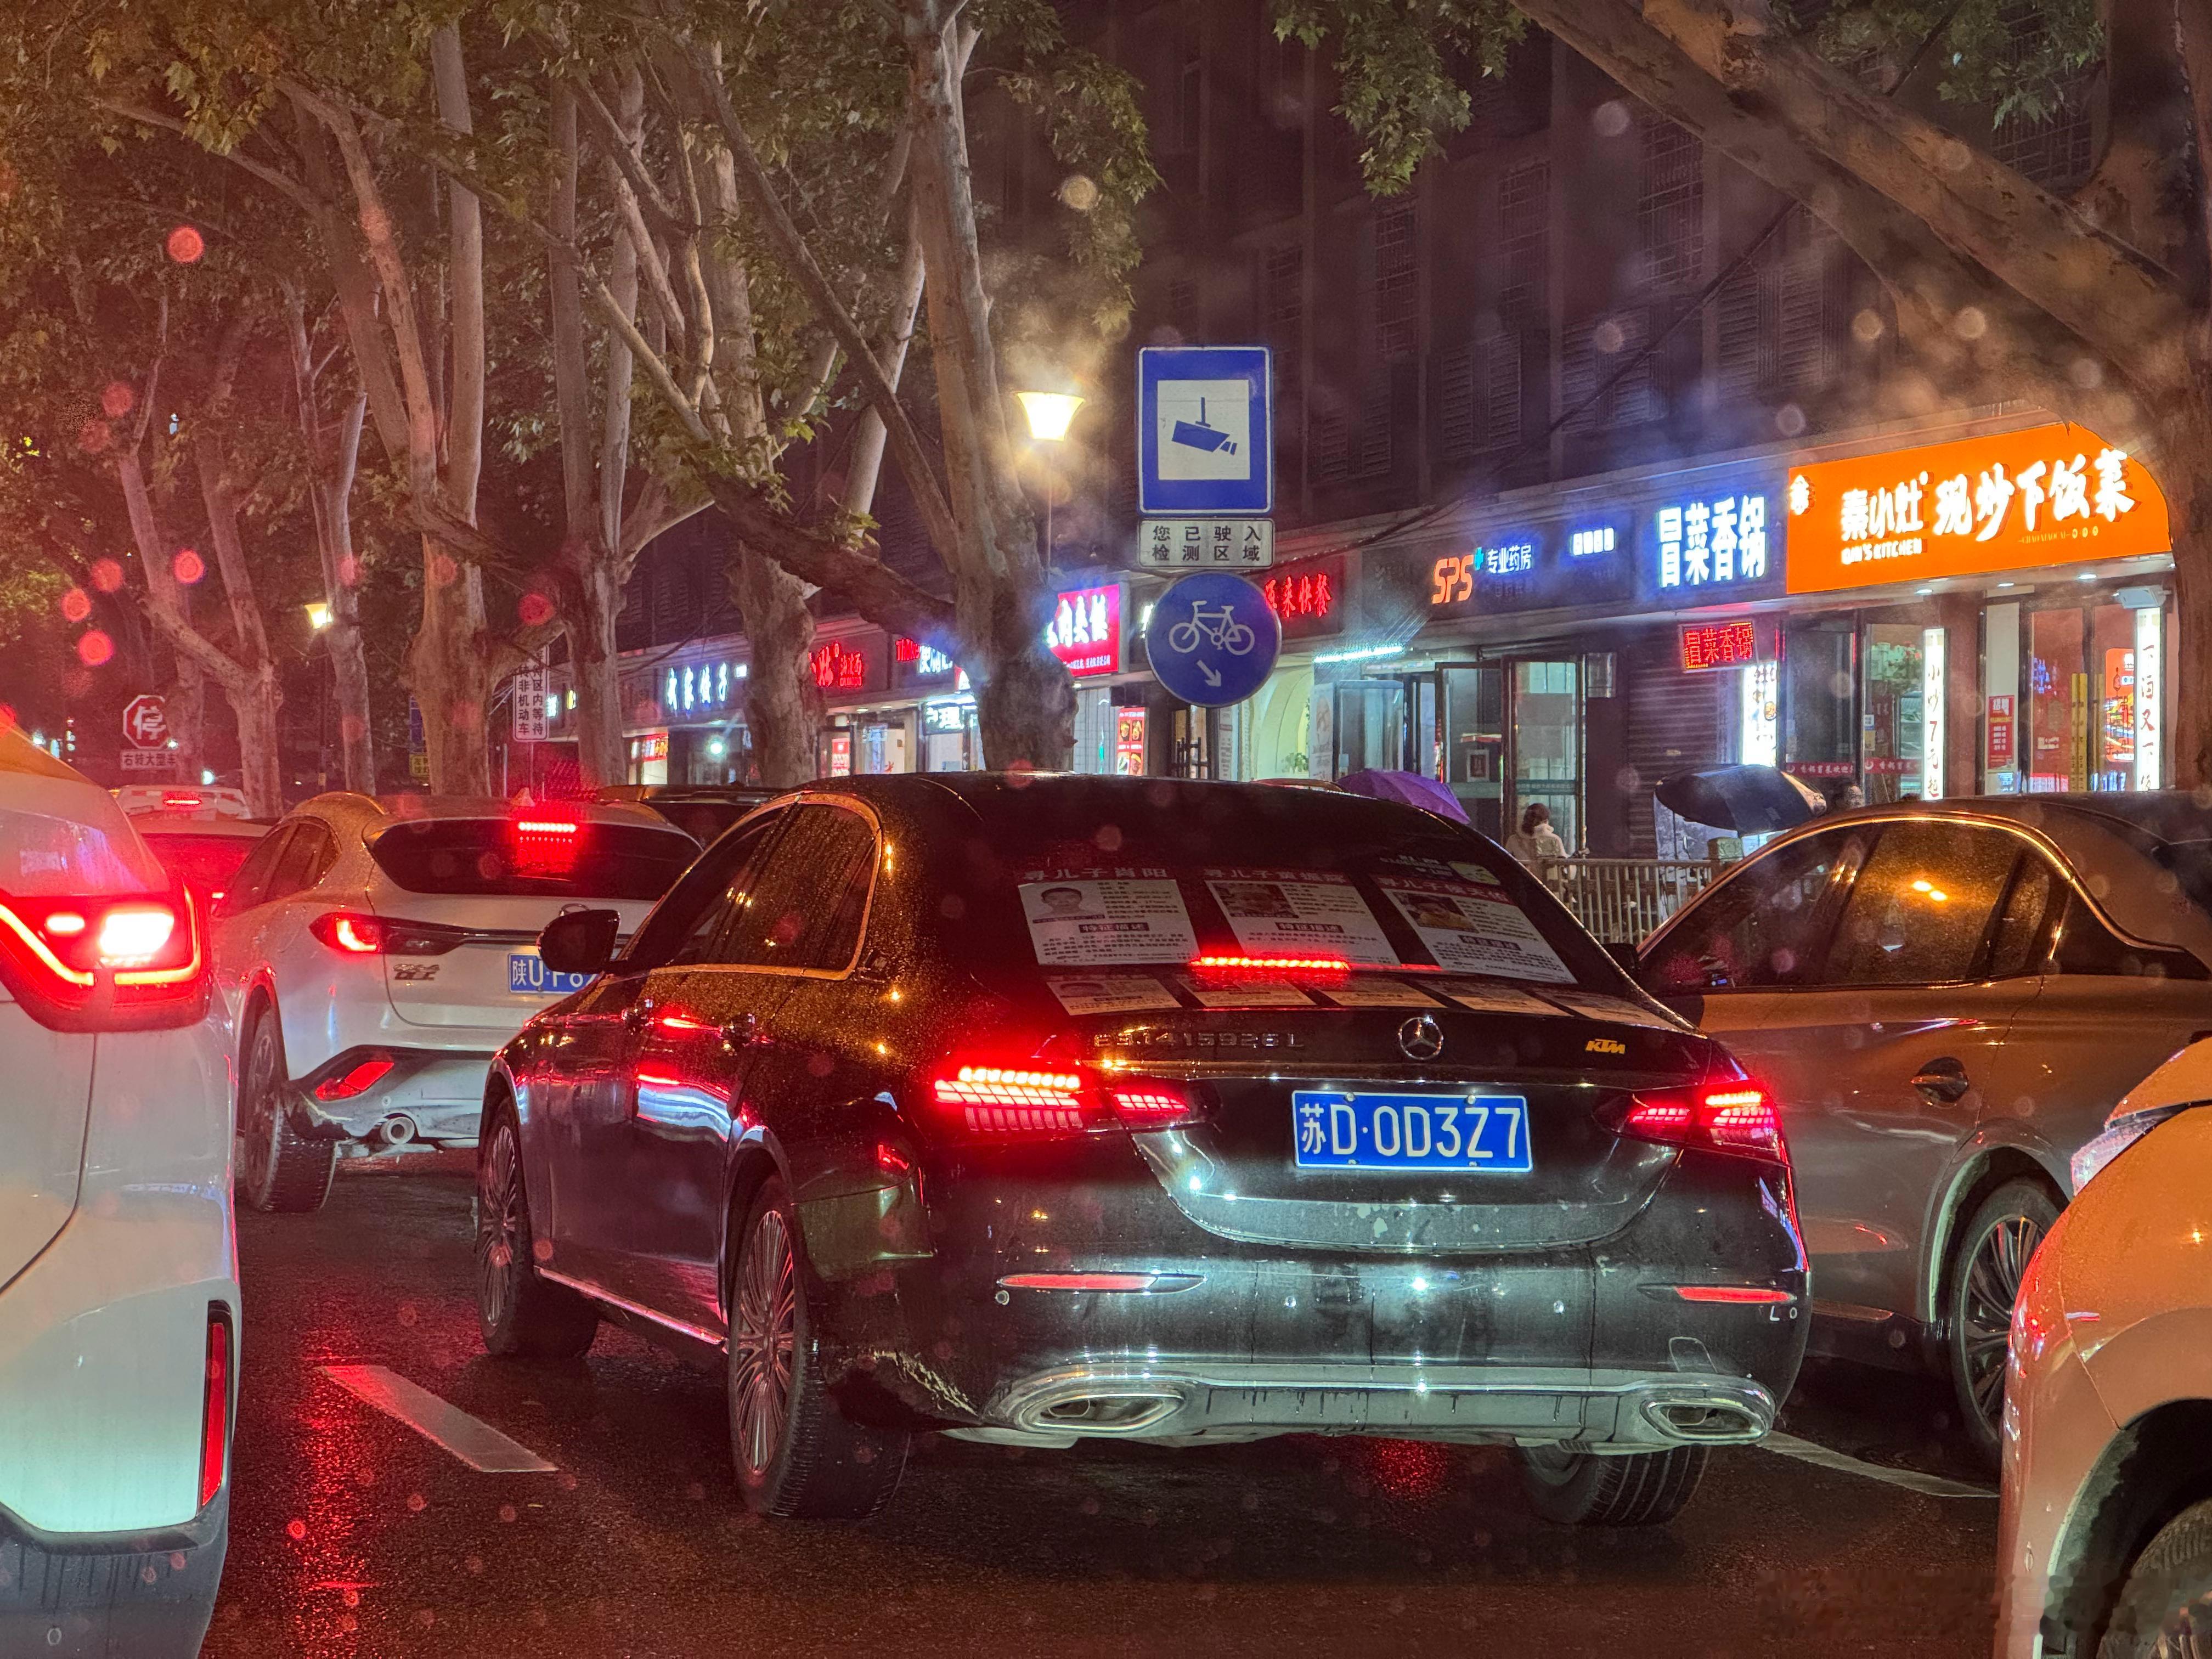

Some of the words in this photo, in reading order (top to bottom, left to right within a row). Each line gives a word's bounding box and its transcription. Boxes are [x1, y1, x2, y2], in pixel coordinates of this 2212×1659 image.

[1841, 479, 1924, 541] 秦小灶
[1933, 448, 2136, 541] 现炒下饭菜
[1153, 526, 1261, 541] 您已驶入
[1658, 495, 1766, 588] 冒菜香锅
[1873, 538, 1922, 560] KITCHEN
[1152, 544, 1260, 562] 检测区域
[1487, 544, 1532, 574] 专业药房
[1432, 554, 1474, 604] SPS
[1684, 625, 1754, 664] 冒菜香锅
[133, 706, 167, 740] 停
[1023, 867, 1169, 881] 寻儿子肖阳
[1585, 1039, 1625, 1054] KTM
[1300, 1103, 1521, 1158] 苏D·0D3Z7
